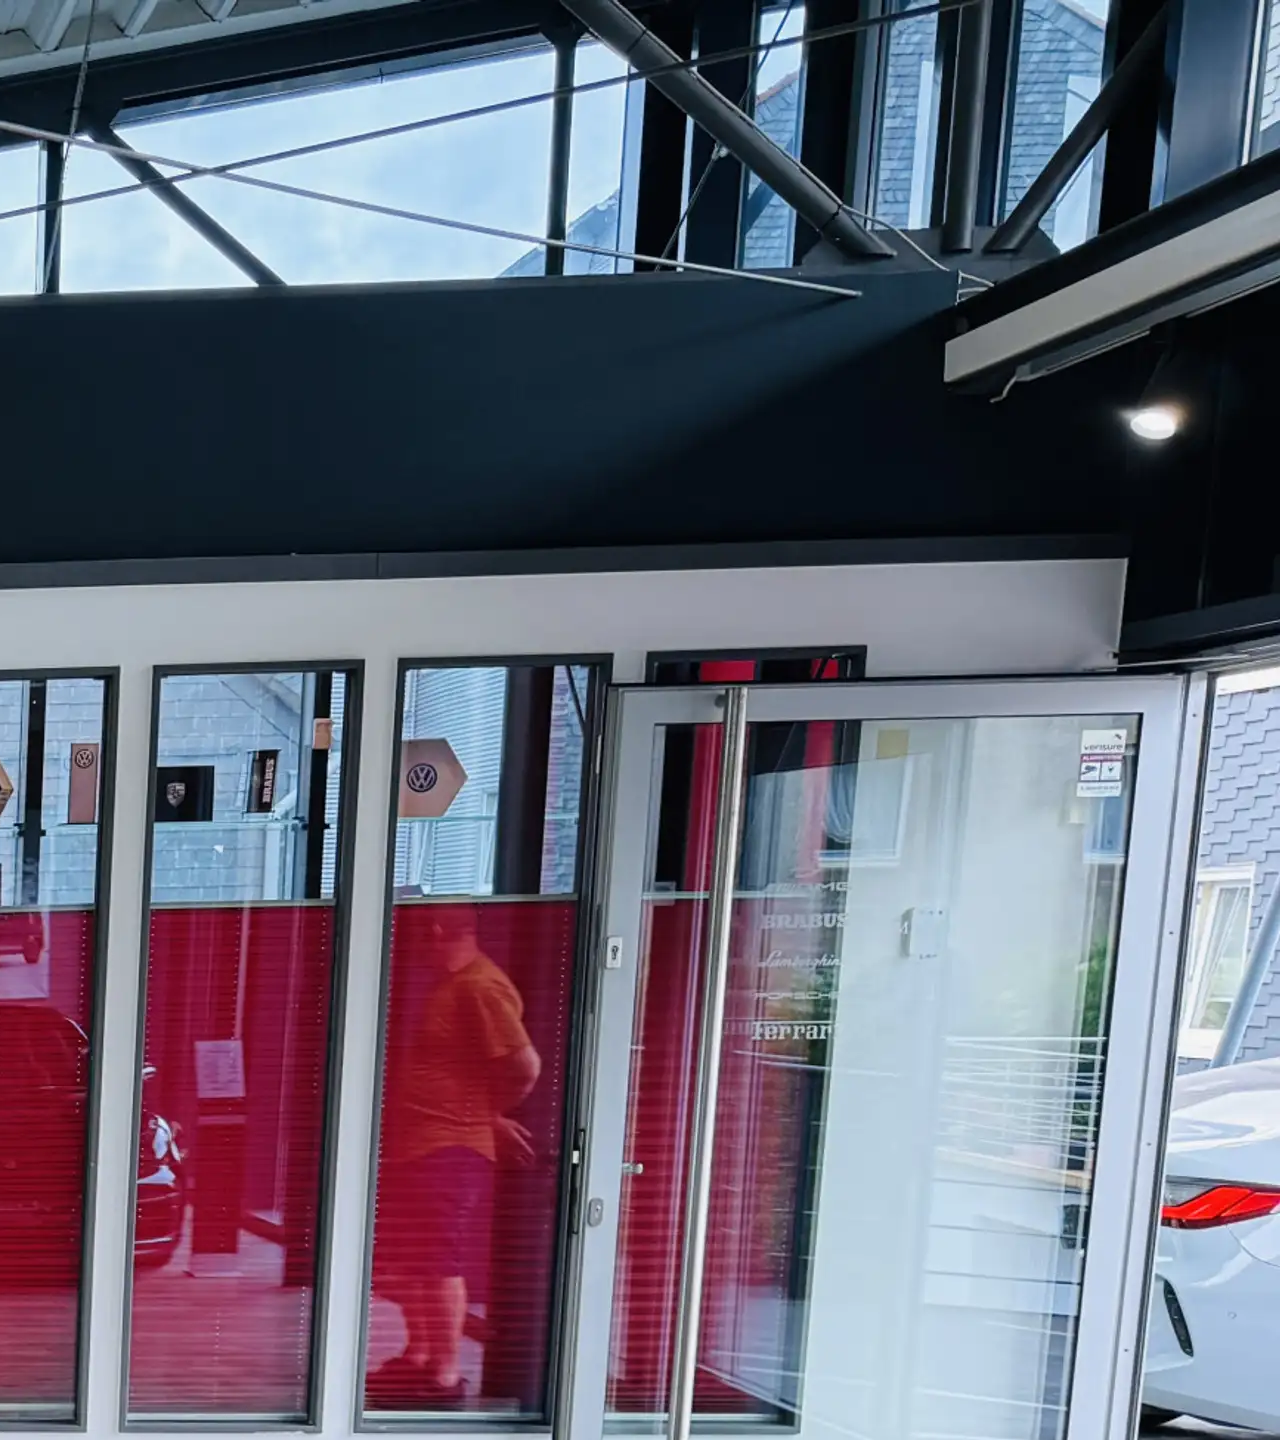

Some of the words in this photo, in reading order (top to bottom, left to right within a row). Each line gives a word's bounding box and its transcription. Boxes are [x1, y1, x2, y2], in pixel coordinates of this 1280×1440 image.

[262, 758, 275, 803] BRABUS
[762, 912, 849, 930] BRABUS
[751, 1020, 836, 1041] Ferrar
